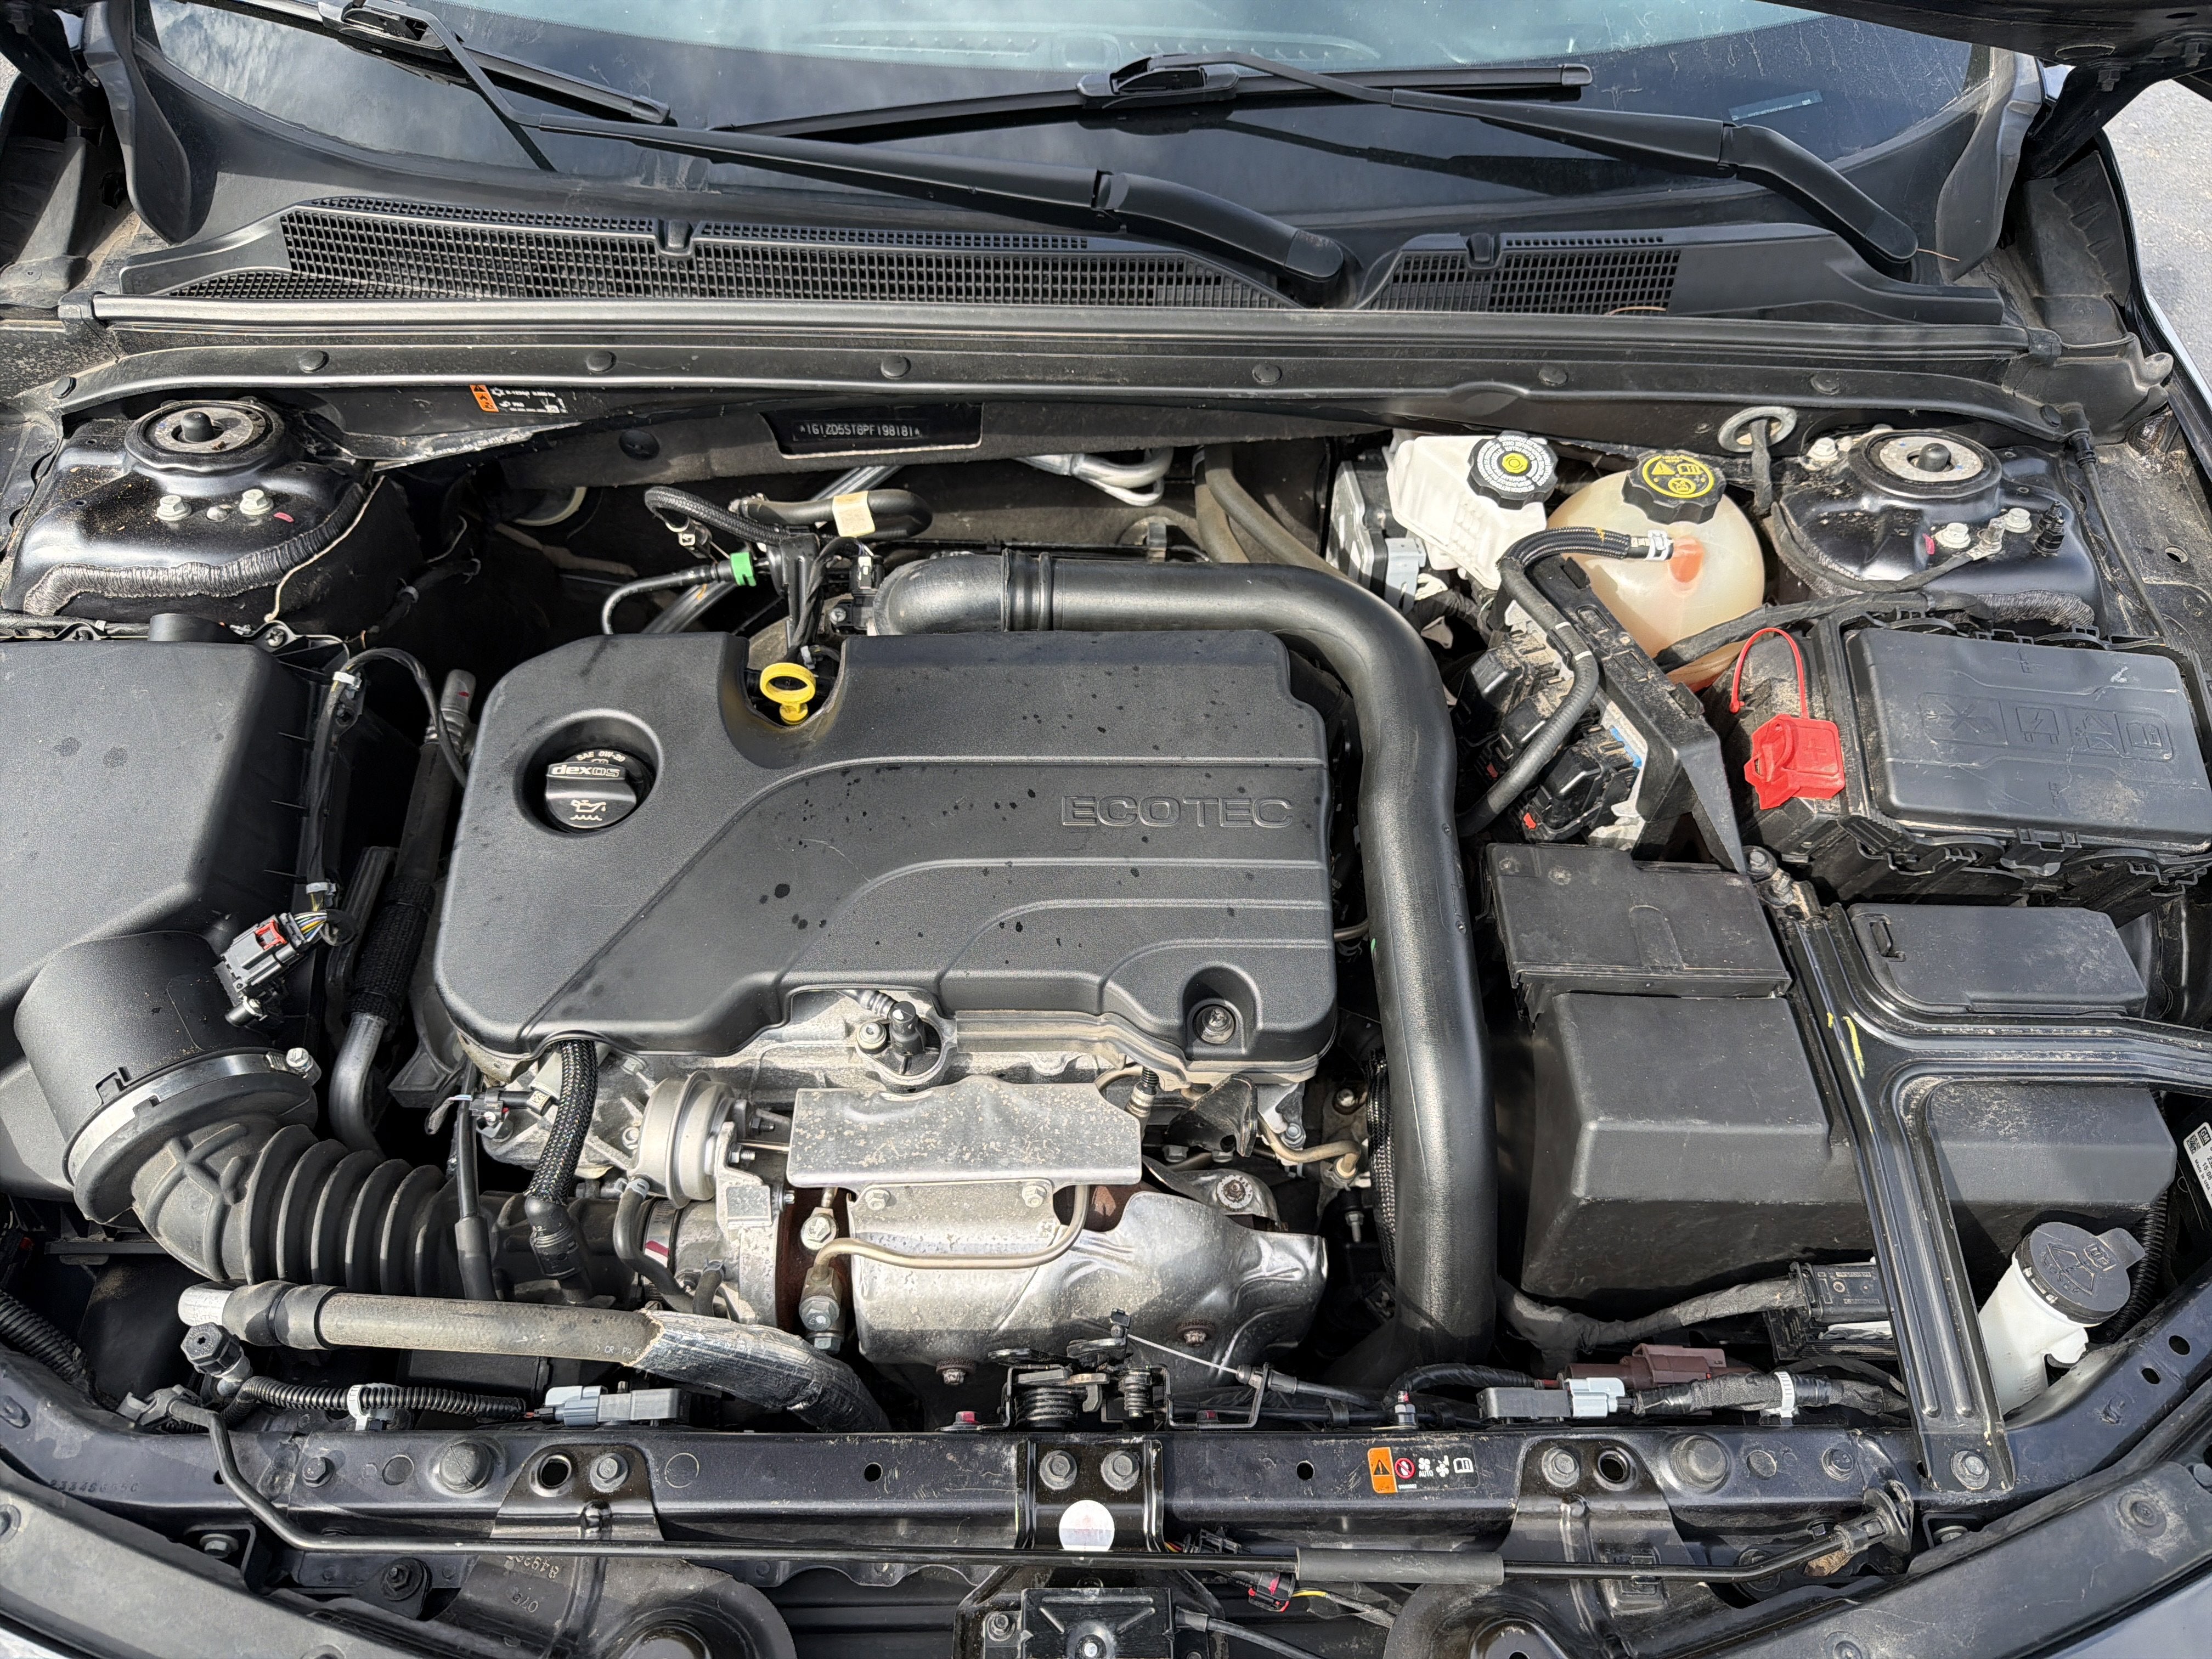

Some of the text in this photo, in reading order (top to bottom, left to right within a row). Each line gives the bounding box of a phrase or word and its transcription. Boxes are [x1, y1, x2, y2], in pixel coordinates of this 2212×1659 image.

[576, 751, 594, 761] SAE
[552, 765, 620, 777] dexos
[1062, 796, 1293, 827] ECOTEC
[2200, 1128, 2210, 1144] GM
